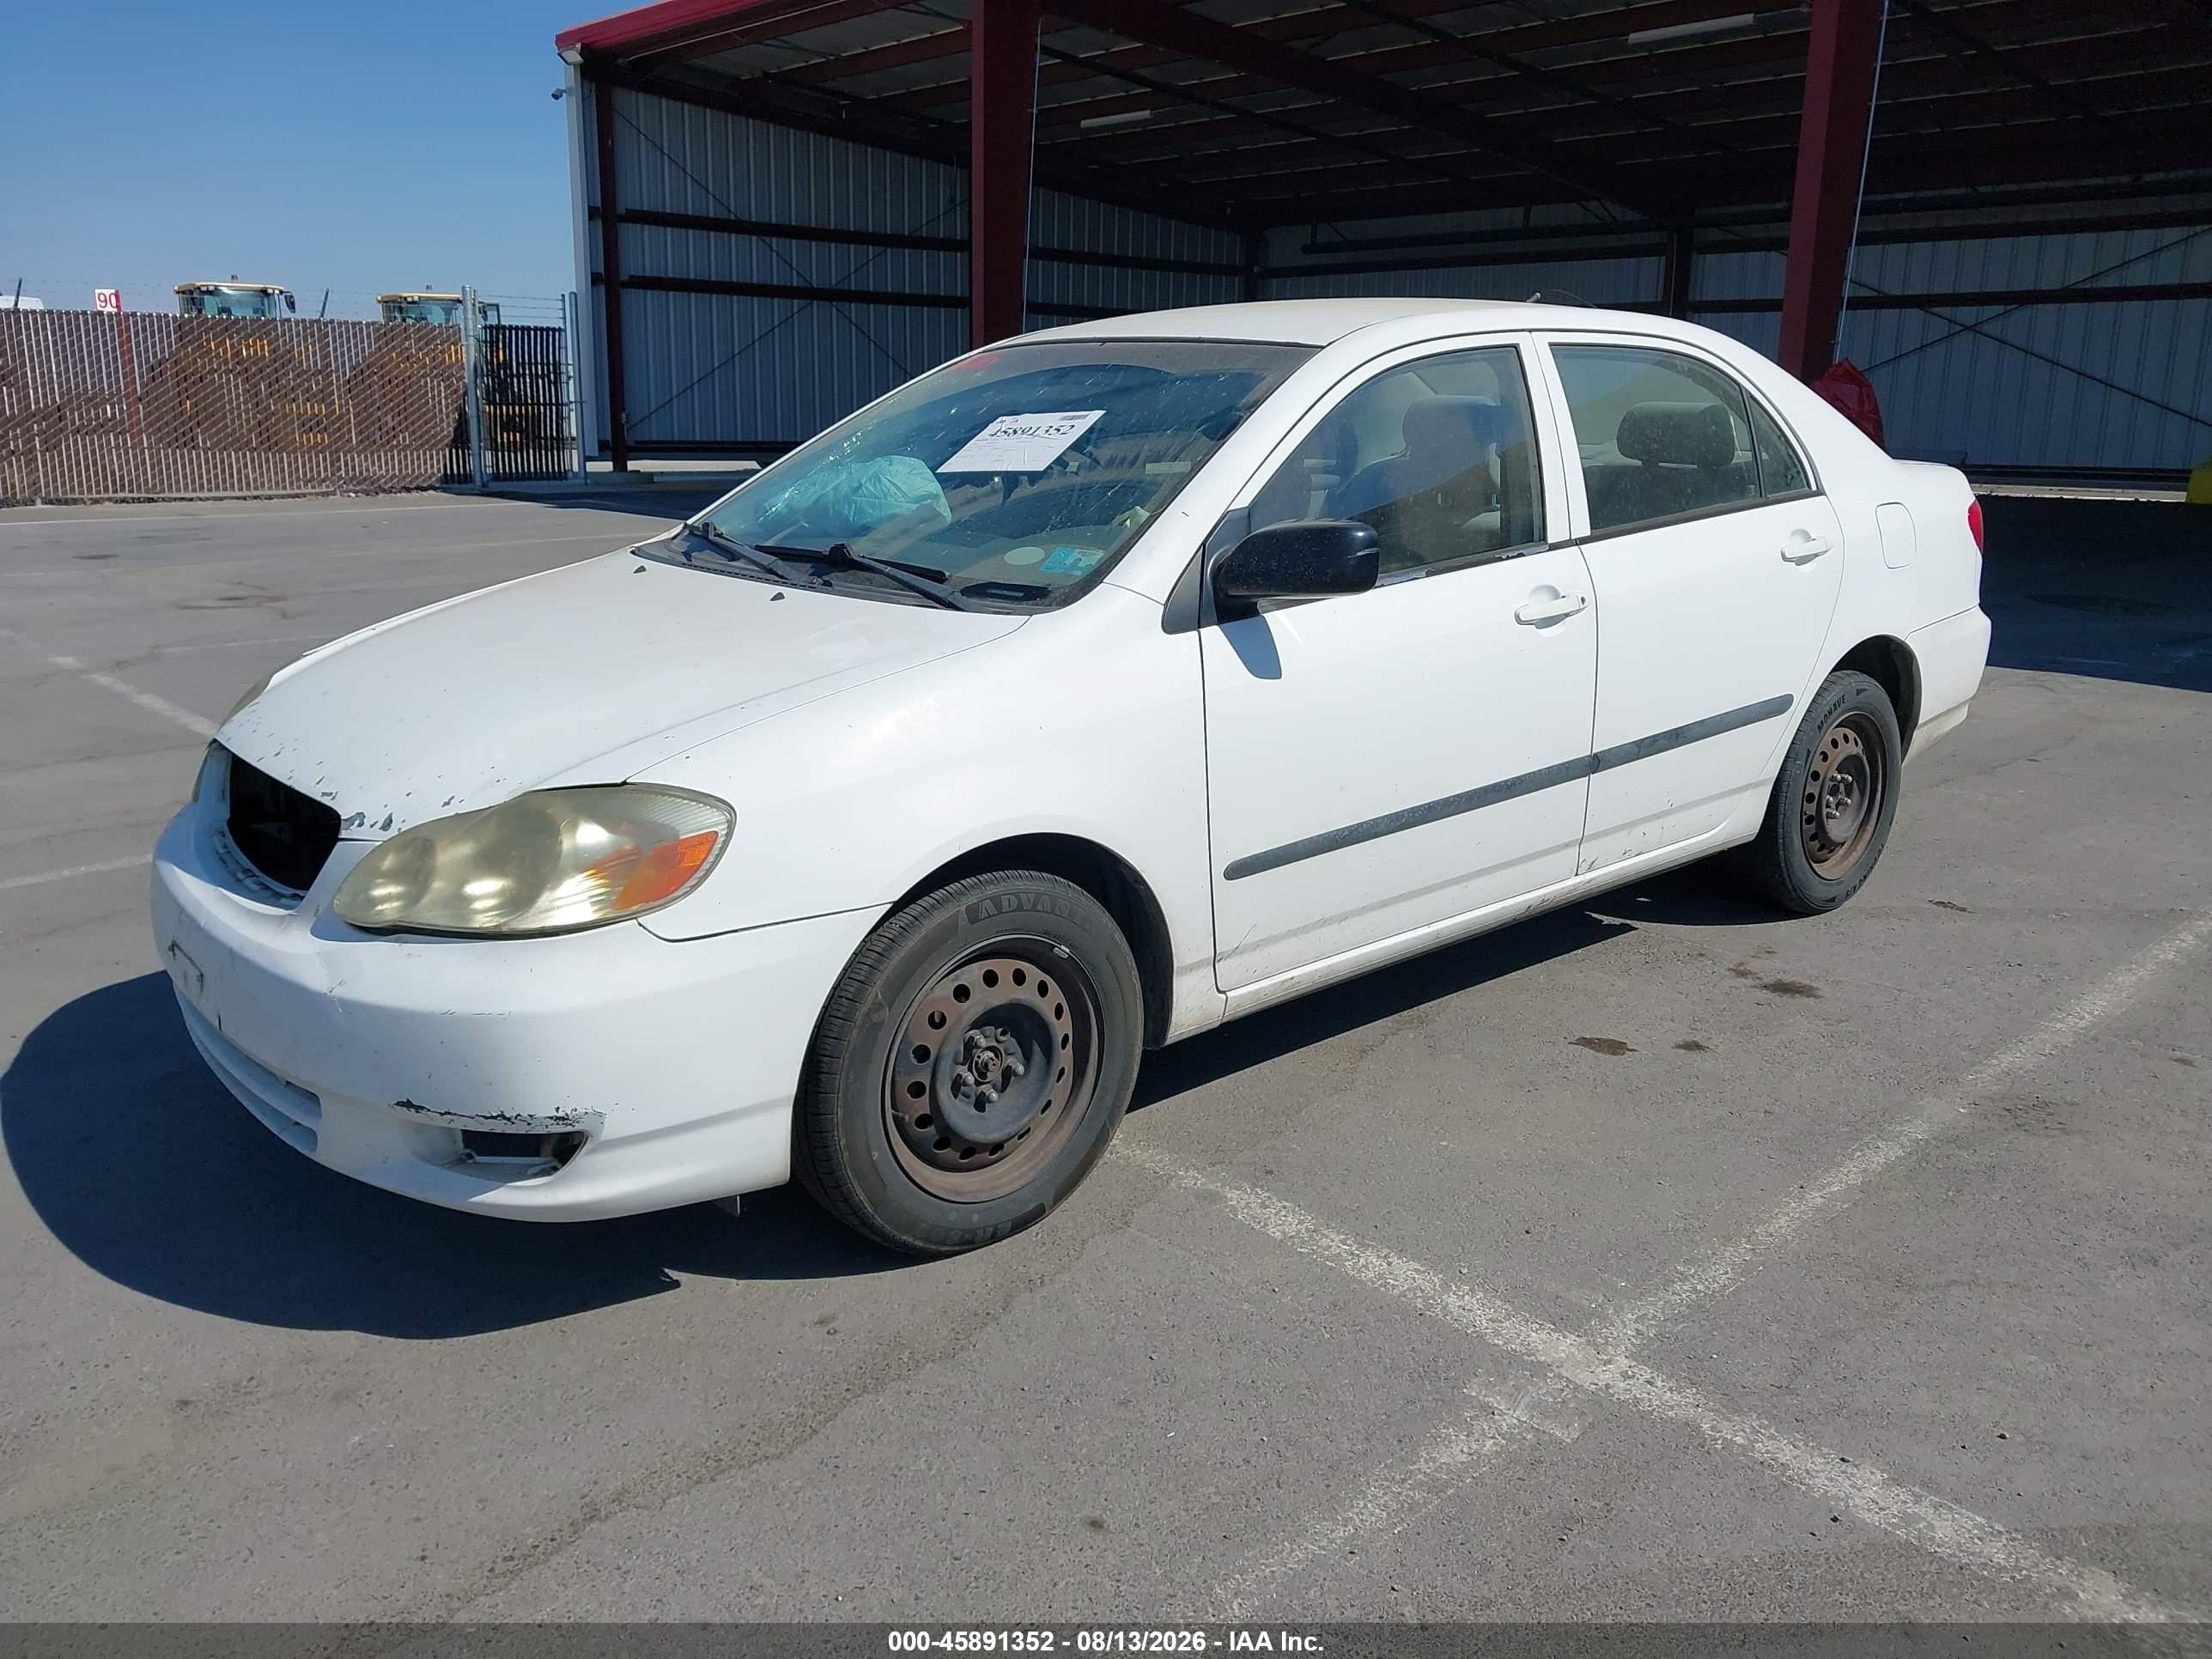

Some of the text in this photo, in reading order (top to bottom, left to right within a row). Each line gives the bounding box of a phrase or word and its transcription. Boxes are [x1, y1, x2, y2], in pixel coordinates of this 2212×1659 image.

[97, 292, 118, 309] 90
[988, 423, 1075, 438] 45891352
[1817, 695, 1845, 734] MOHAVE
